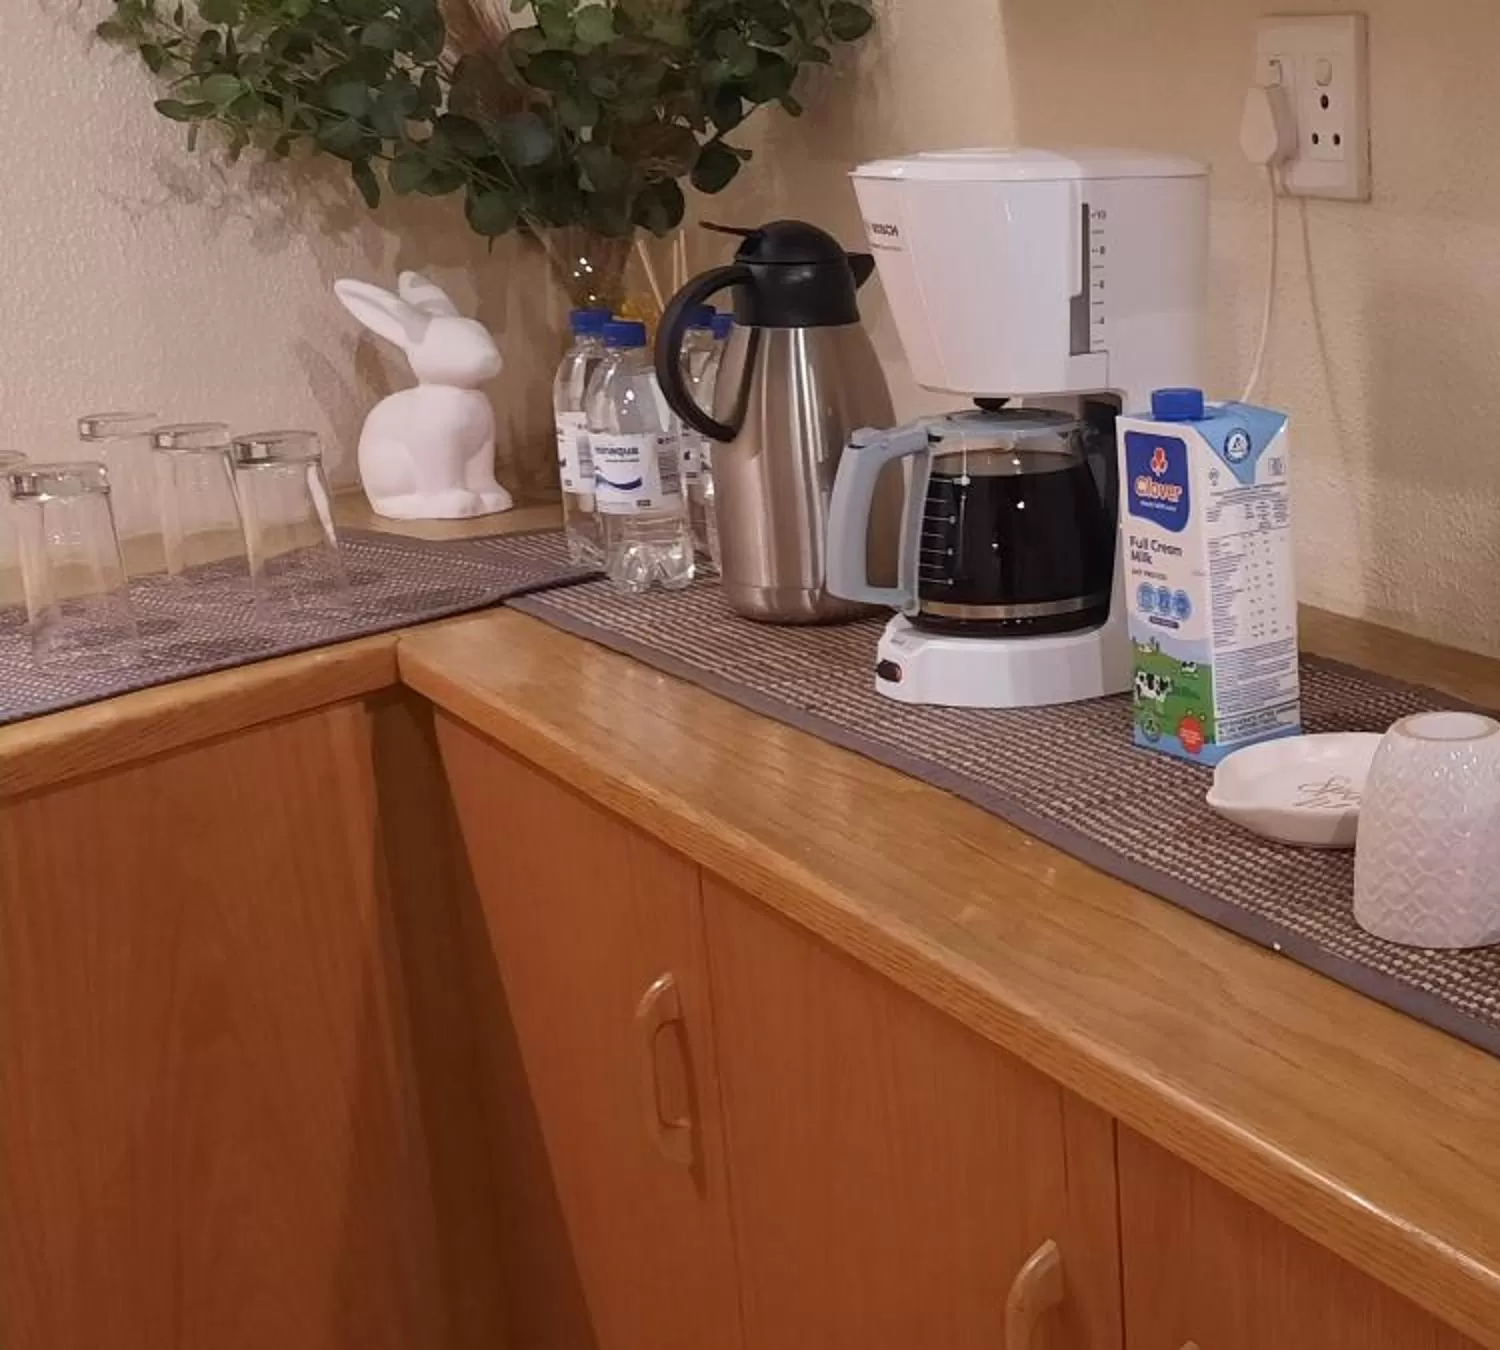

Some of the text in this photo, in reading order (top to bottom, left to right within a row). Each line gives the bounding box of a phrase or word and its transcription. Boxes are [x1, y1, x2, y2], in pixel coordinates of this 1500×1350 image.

[1135, 474, 1184, 503] Clover
[1129, 535, 1184, 557] Full Cream
[1131, 550, 1153, 565] Milk
